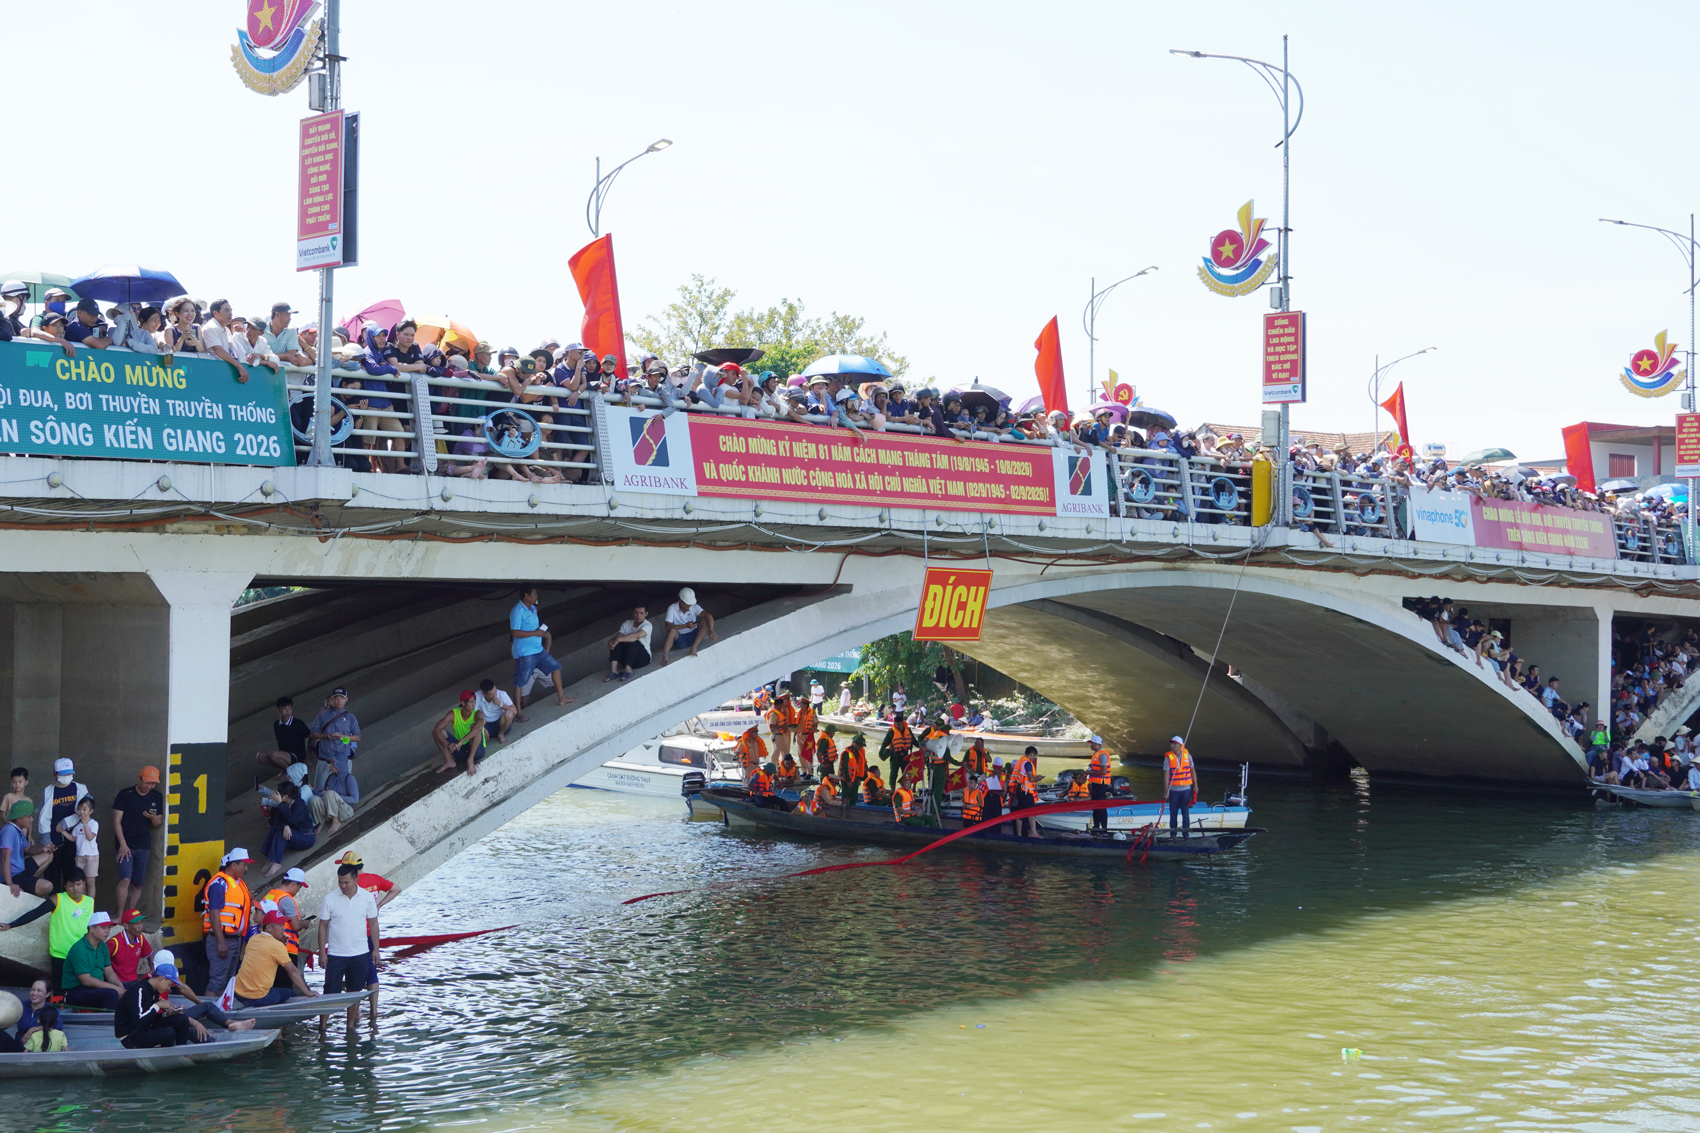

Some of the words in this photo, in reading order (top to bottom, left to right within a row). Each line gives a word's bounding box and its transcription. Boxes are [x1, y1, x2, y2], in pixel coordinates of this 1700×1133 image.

[299, 244, 330, 257] Vietcombank
[56, 355, 115, 383] CHÀO
[125, 360, 187, 389] MỪNG
[19, 389, 58, 412] ĐUA,
[65, 392, 93, 411] BƠI
[99, 391, 161, 415] THUYỀN
[167, 396, 223, 420] TRUYỀN
[228, 401, 276, 424] THỐNG
[30, 415, 94, 447] SÔNG
[103, 418, 153, 450] KIẾN
[163, 428, 226, 454] GIANG
[234, 433, 281, 458] 2026
[719, 433, 746, 454] CHÀO
[748, 435, 776, 456] MỪNG
[778, 436, 791, 458] KỶ
[792, 440, 816, 462] NIỆM
[818, 444, 829, 461] 81
[832, 442, 850, 462] NĂM
[854, 444, 876, 464] CÁCH
[878, 448, 902, 468] MẠNG
[904, 449, 931, 468] THÁNG
[932, 451, 949, 470] TÁM
[950, 455, 990, 473] (19/8/1945
[996, 458, 1032, 478] 19/8/2026)
[623, 474, 689, 490] AGRIBANK
[703, 460, 718, 480] VÀ
[720, 459, 746, 482] QUỐC
[748, 463, 780, 484] KHÁNH
[782, 465, 808, 486] NƯỚC
[810, 468, 834, 490] CỘNG
[836, 468, 854, 489] HOÀ
[854, 472, 867, 490] XÃ
[868, 474, 884, 492] HỘI
[884, 472, 902, 492] CHỦ
[903, 475, 928, 494] NGHĨA
[928, 475, 946, 498] VIỆT
[947, 480, 965, 496] NAM
[966, 482, 1006, 500] (02/9/1945
[1011, 484, 1050, 502] 02/9/2026)!
[1062, 502, 1104, 514] AGRIBANK
[1416, 506, 1454, 524] vinaphone
[1483, 506, 1498, 521] CHÀO
[1498, 507, 1515, 523] MỪNG
[1521, 510, 1531, 526] HỘI
[1553, 513, 1572, 530] THUYỀN
[1572, 515, 1590, 532] TRUYỀN
[1506, 527, 1522, 542] TRÊN
[1521, 528, 1536, 544] SÔNG
[1535, 528, 1548, 544] KIẾN
[1548, 532, 1564, 546] GIANG
[1564, 533, 1575, 548] NĂM
[922, 576, 986, 628] ĐÍCH
[192, 774, 208, 814] 1
[193, 868, 212, 913] 2
